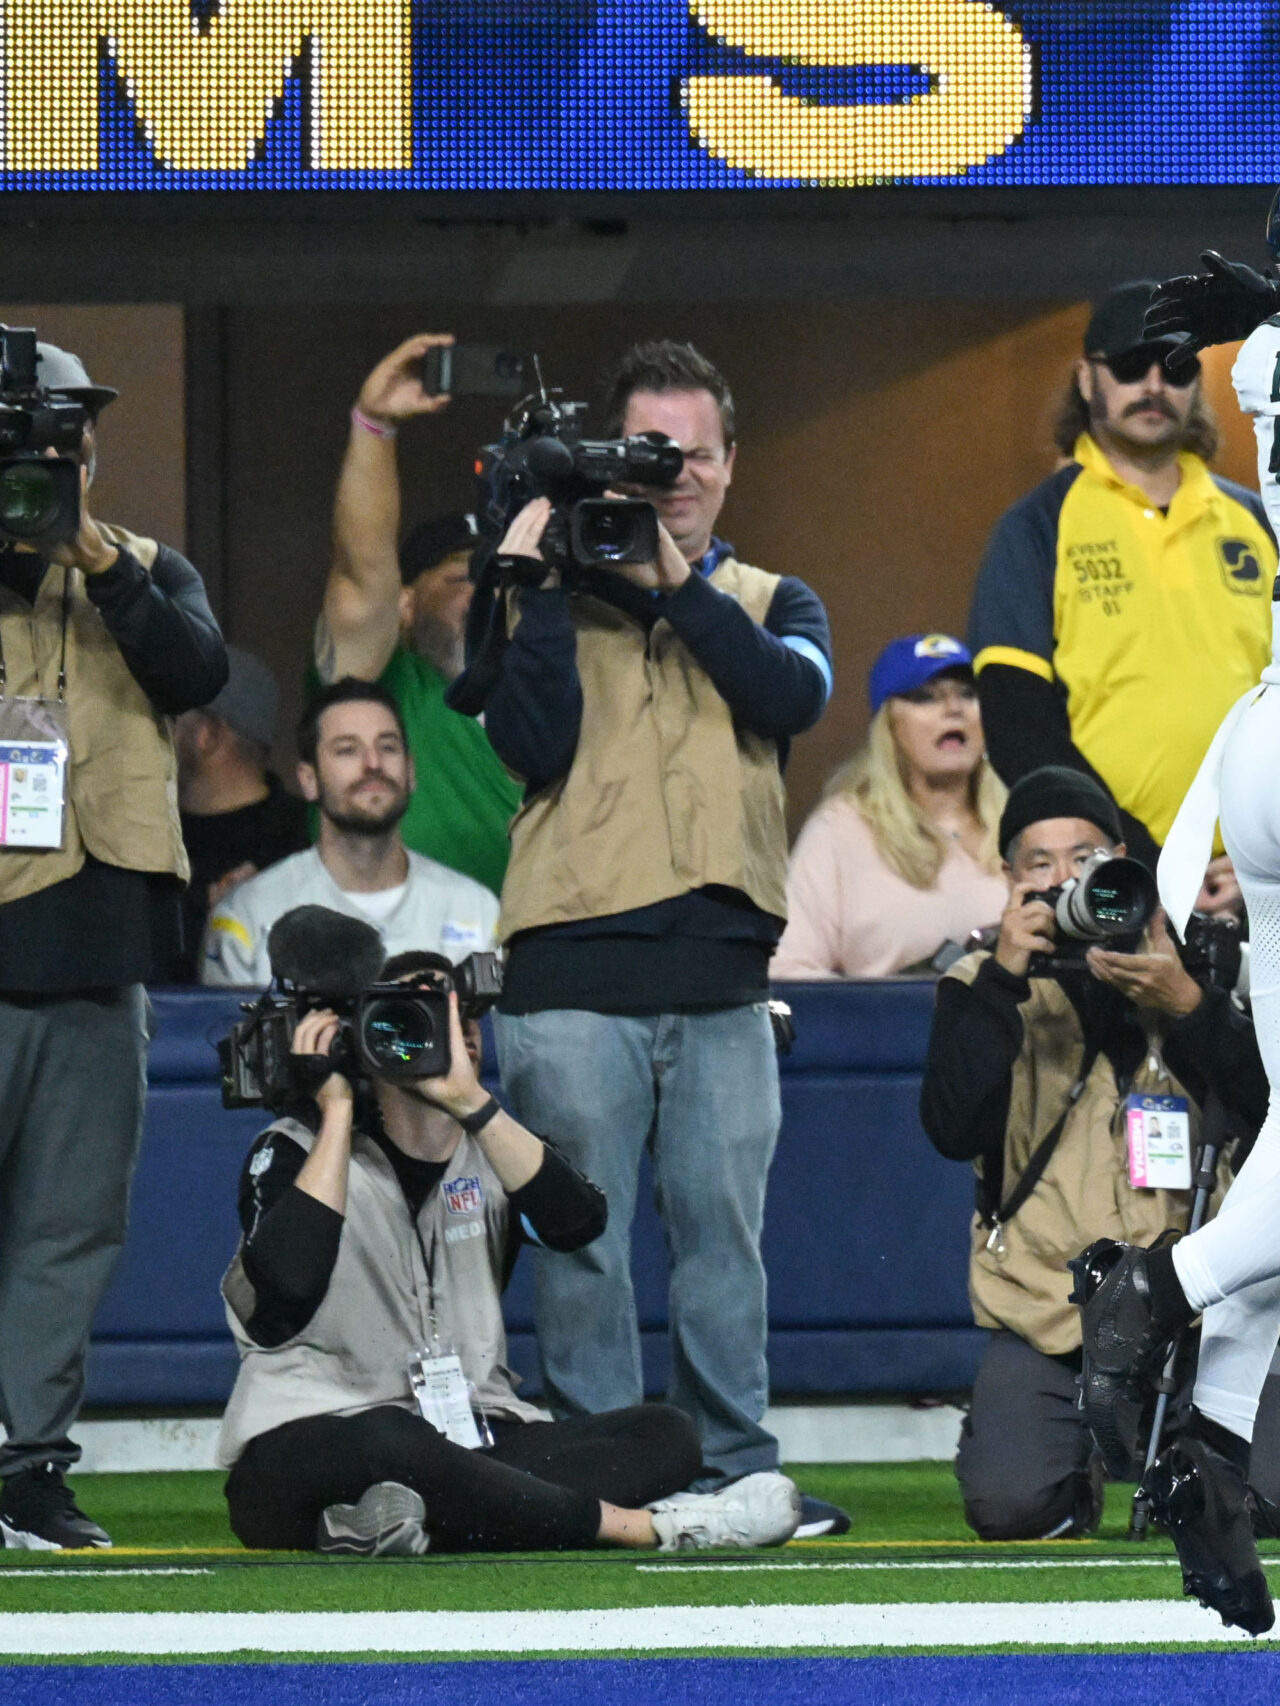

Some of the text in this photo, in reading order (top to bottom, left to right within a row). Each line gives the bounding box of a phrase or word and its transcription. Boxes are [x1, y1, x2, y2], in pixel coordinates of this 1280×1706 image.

[1067, 540, 1118, 557] EVENT
[1072, 557, 1125, 583] 5032
[1079, 582, 1134, 602] STAFF
[1131, 1117, 1146, 1179] MEDIA
[449, 1189, 479, 1211] NFL
